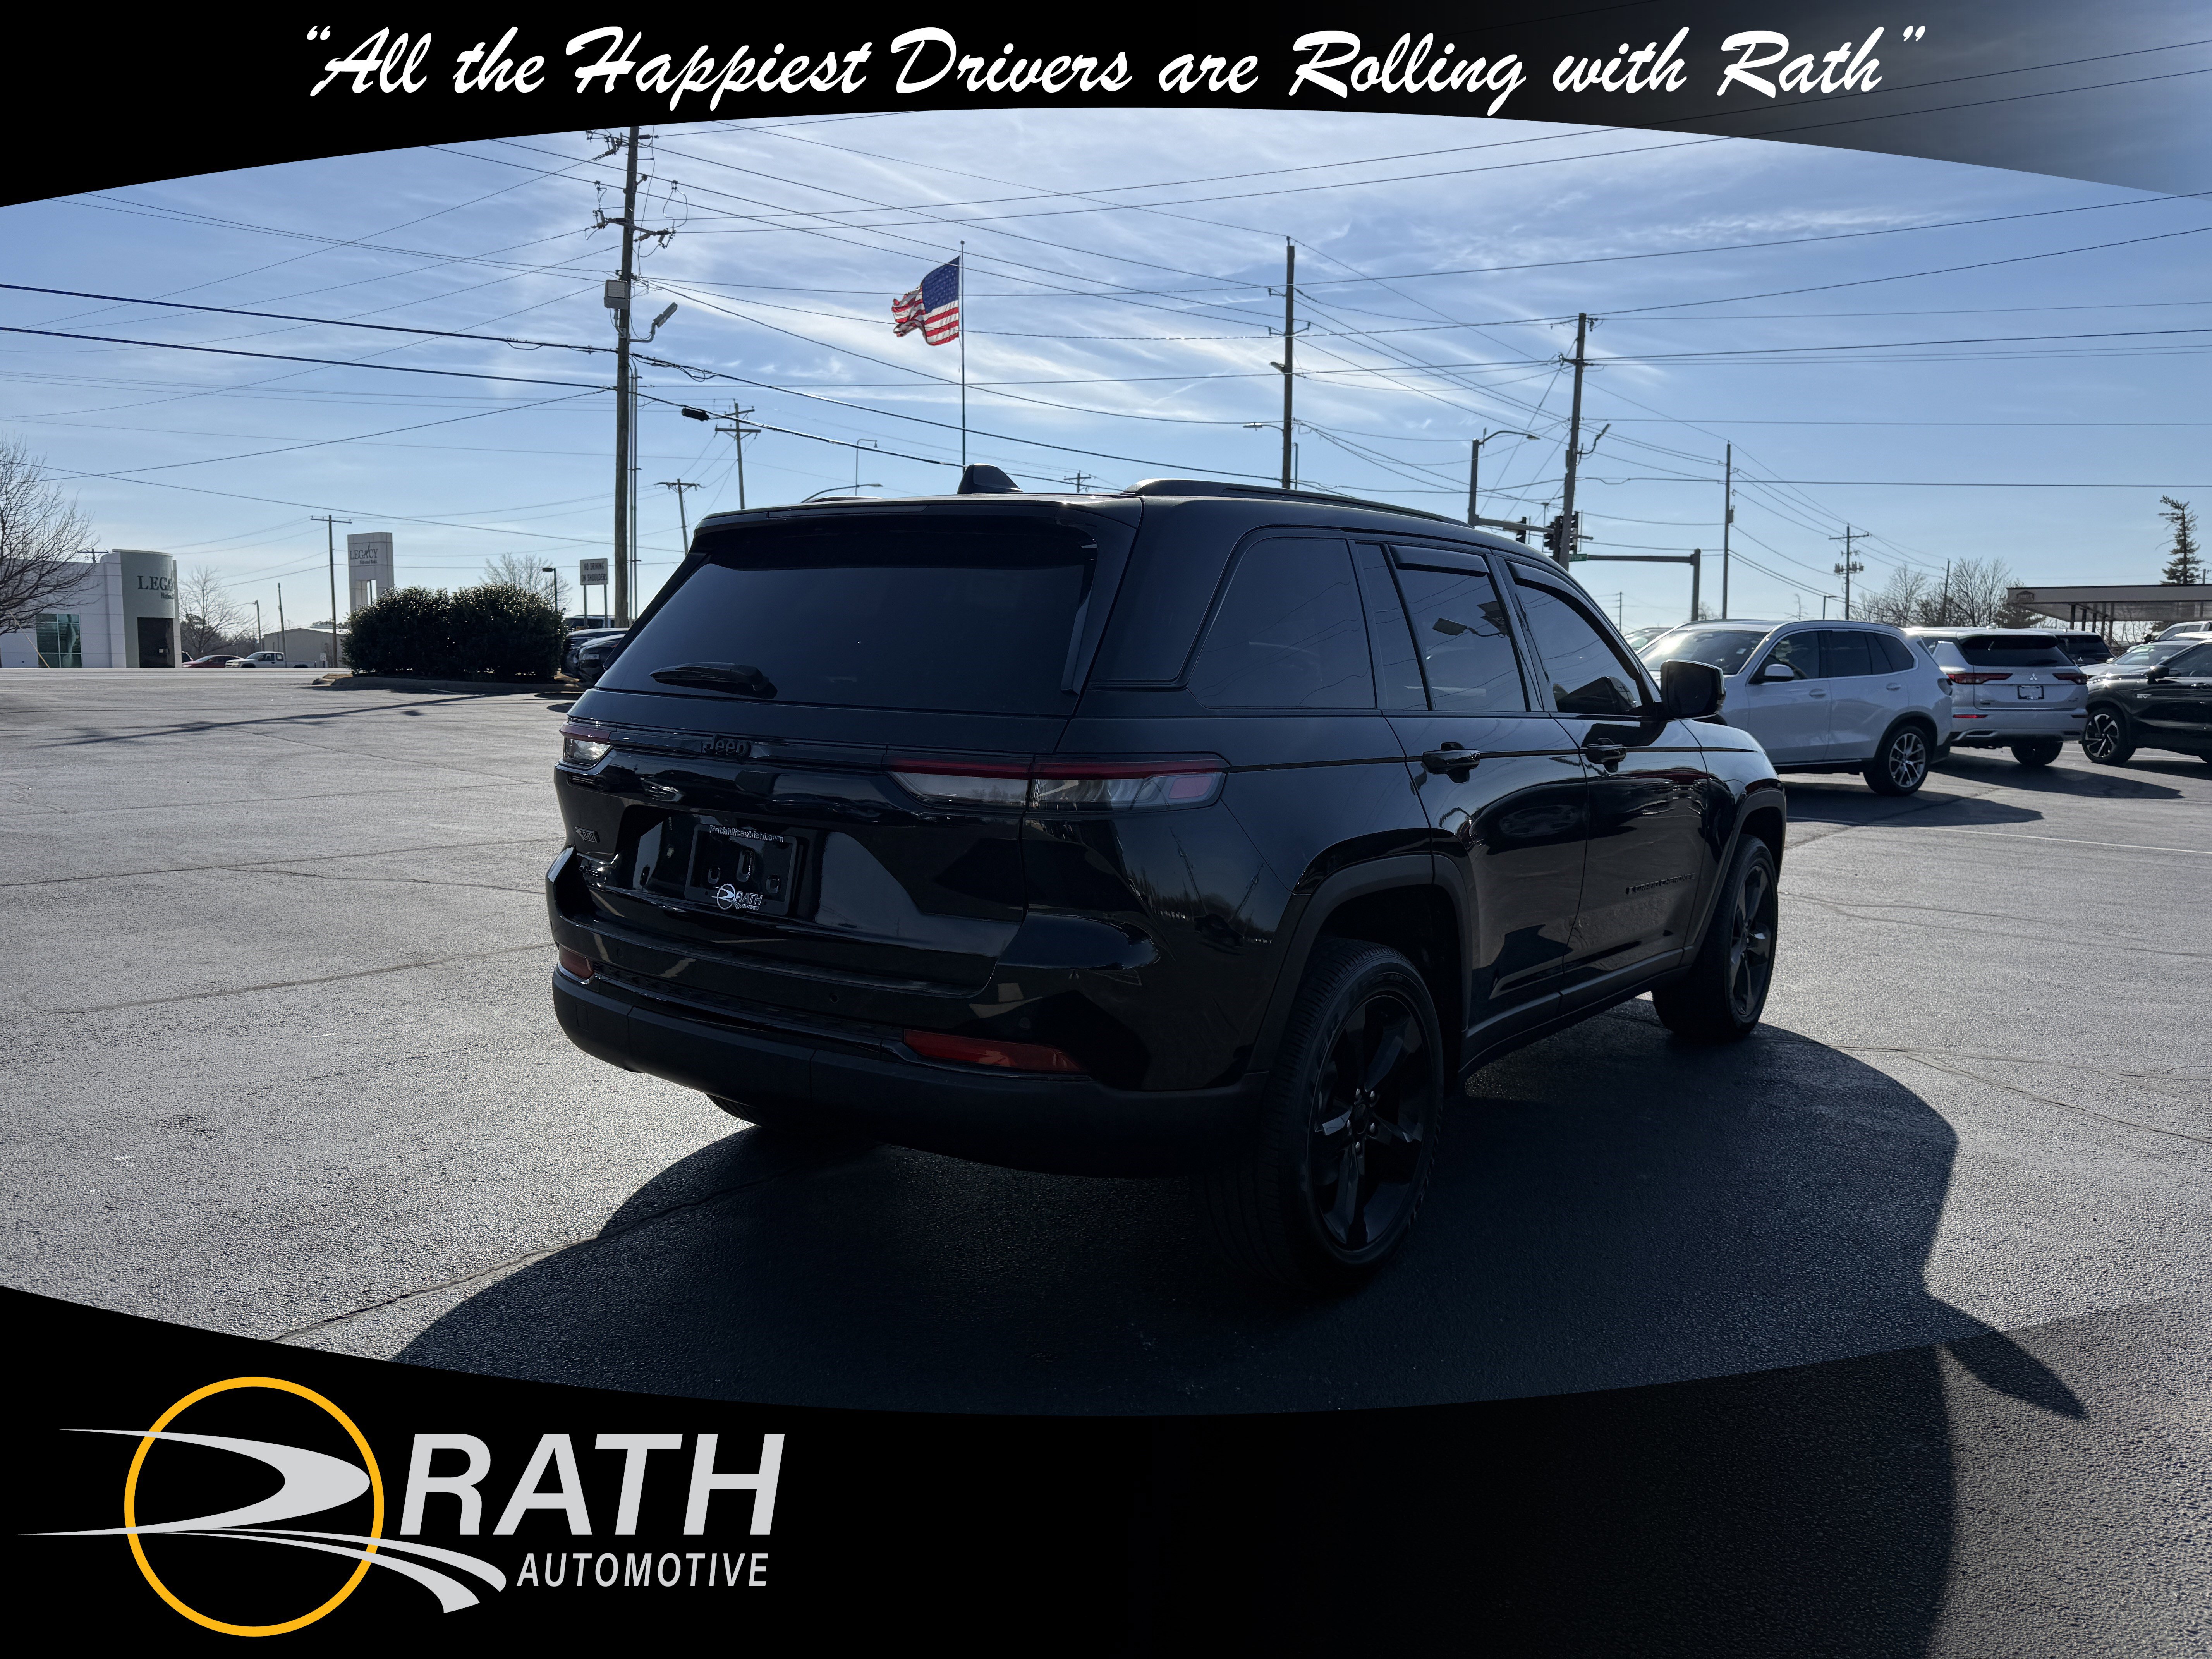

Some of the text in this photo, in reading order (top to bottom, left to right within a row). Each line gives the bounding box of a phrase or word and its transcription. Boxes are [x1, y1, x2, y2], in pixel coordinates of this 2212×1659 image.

[350, 543, 378, 560] LEGACY
[590, 562, 605, 570] DRIVING
[735, 891, 763, 906] RATH
